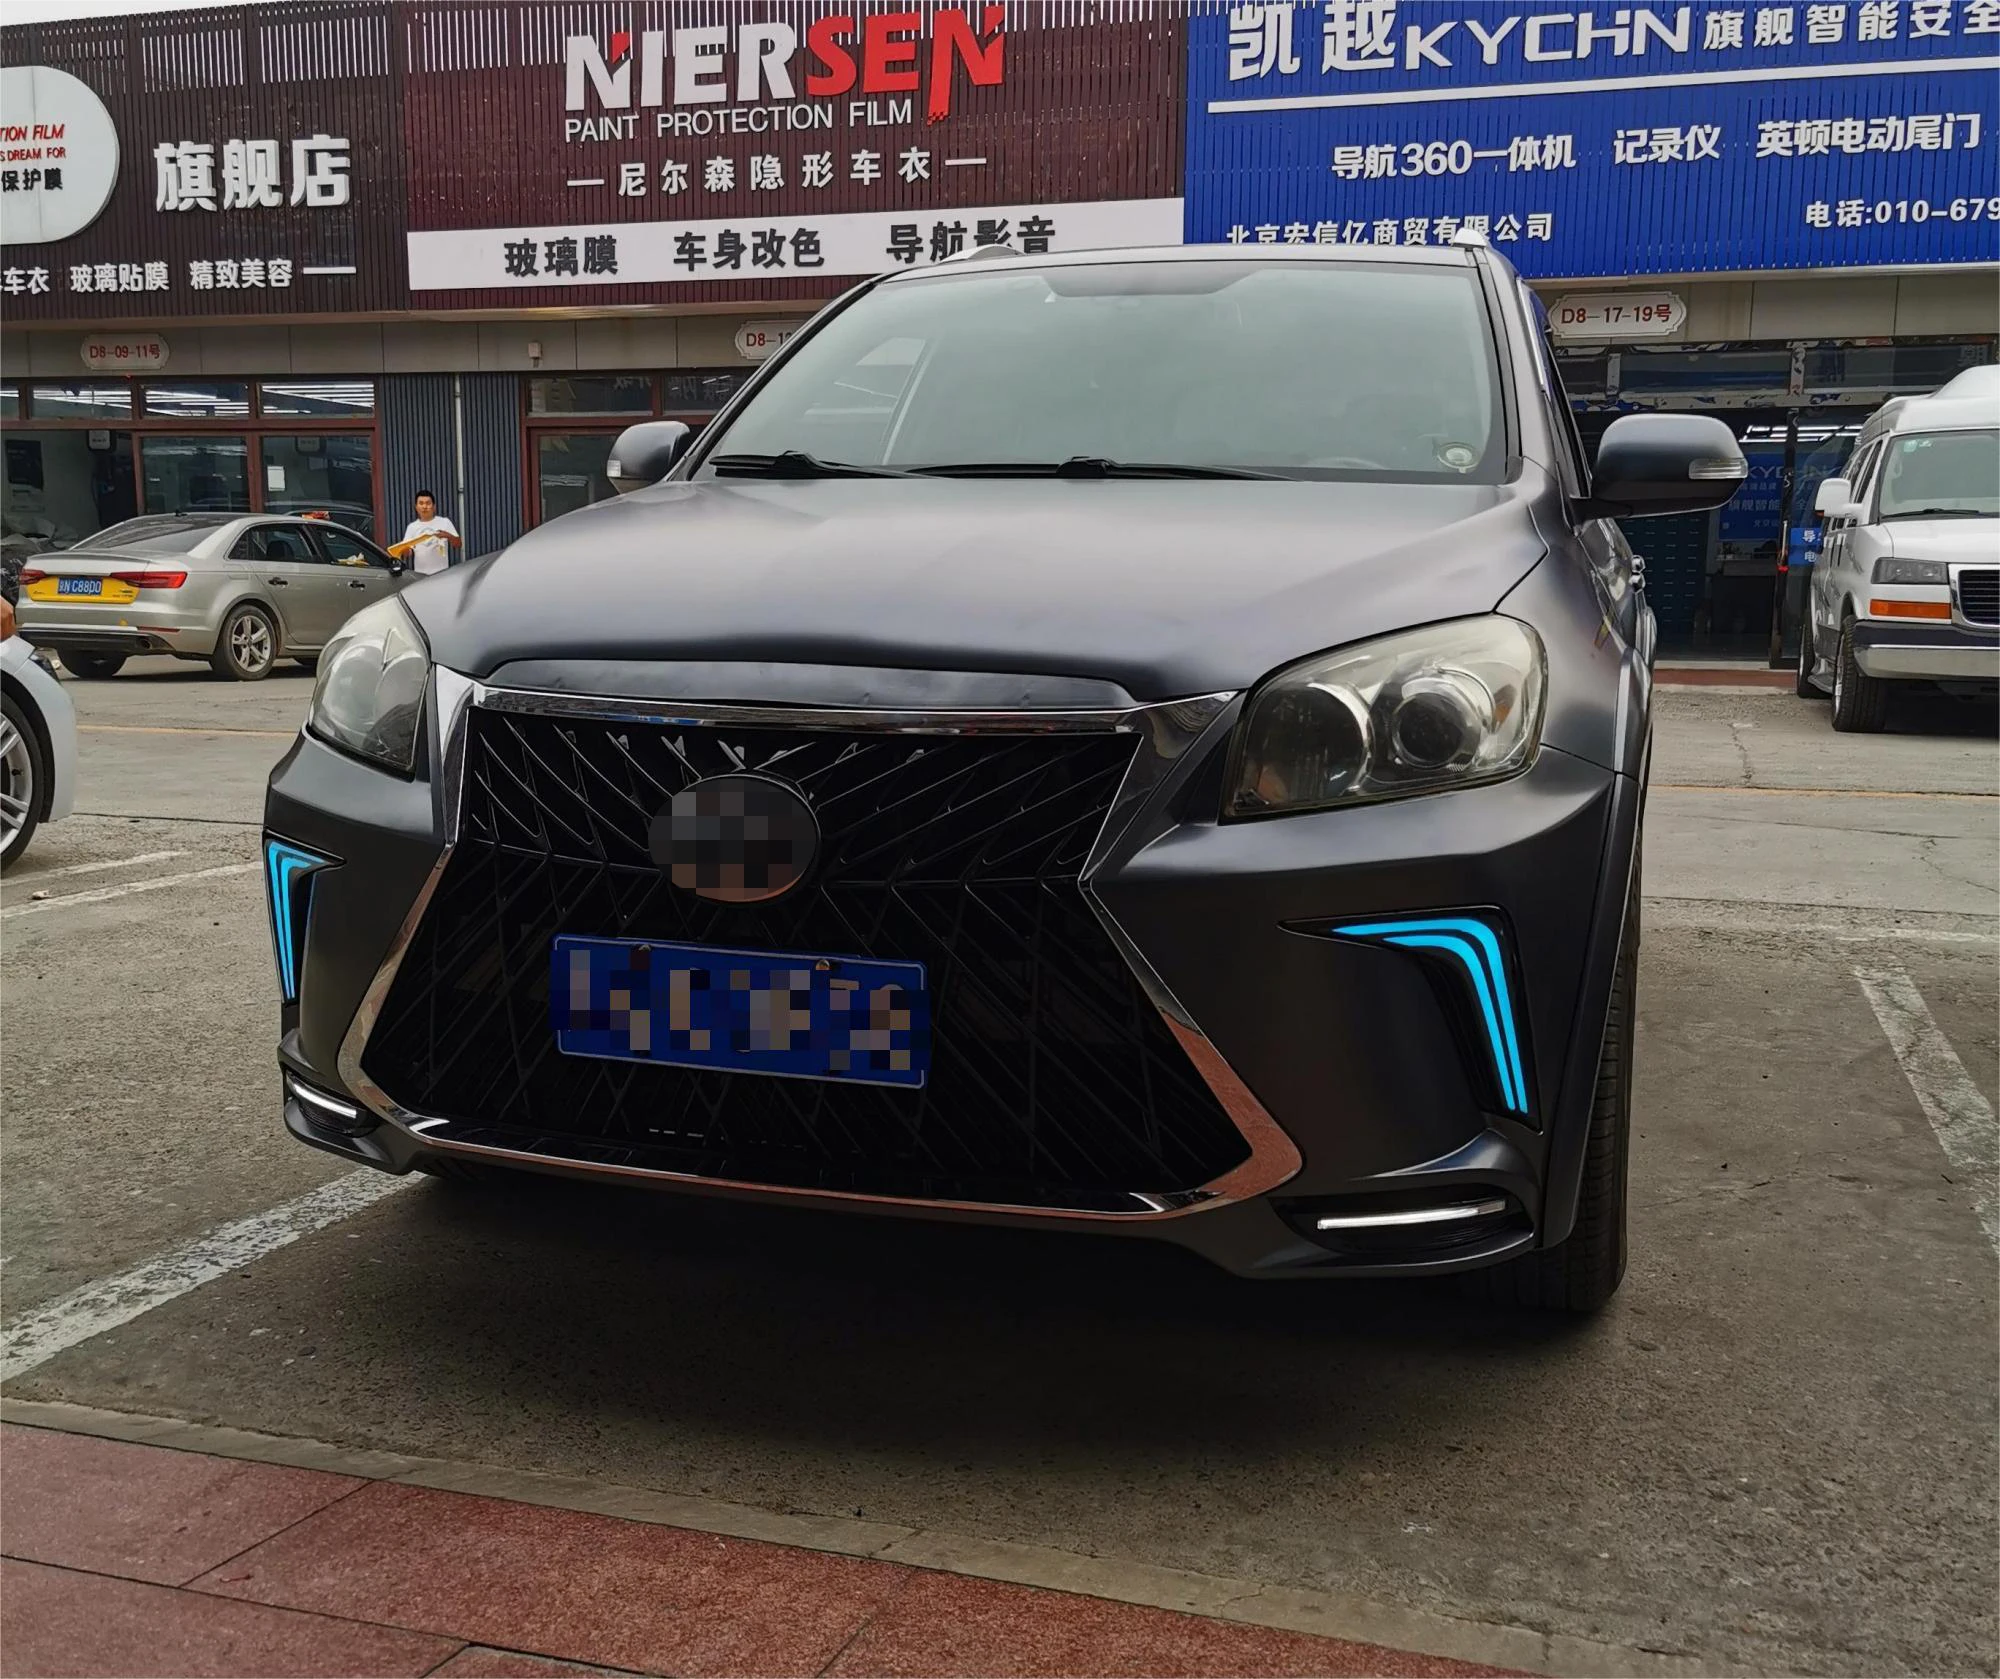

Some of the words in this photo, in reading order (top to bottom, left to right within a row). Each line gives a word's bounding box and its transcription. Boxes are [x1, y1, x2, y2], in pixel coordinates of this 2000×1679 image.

[1229, 0, 1396, 81] 凯越
[1406, 6, 1691, 70] KYCHN
[1704, 0, 2000, 50] 旗舰智能安全
[565, 5, 1004, 126] NIERSEN
[33, 124, 65, 140] FILM
[565, 115, 639, 143] PAINT
[657, 104, 833, 138] PROTECTION
[849, 99, 912, 127] FILM
[7, 148, 42, 162] DREAM
[46, 146, 67, 159] FOR
[1332, 134, 1576, 180] 导航360一体机
[1613, 125, 1720, 165] 记录仪
[1756, 113, 1981, 158] 英顿电动尾门
[1, 167, 63, 192] 保护膜
[153, 134, 350, 212] 旗舰店
[618, 146, 931, 197] 尼尔森隐形车衣
[1226, 213, 1552, 246] 北京宏信亿商贸有限公司
[1805, 197, 2000, 228] 电话:010-679
[504, 234, 618, 277] 玻璃膜
[673, 228, 825, 272] 车身改色
[886, 215, 1056, 264] 导航影音
[0, 266, 51, 295] 车衣
[70, 261, 170, 293] 玻璃贴膜
[189, 258, 293, 290] 精致美容
[1561, 303, 1673, 325] D8-17-19号
[89, 344, 161, 360] D8-09-11号
